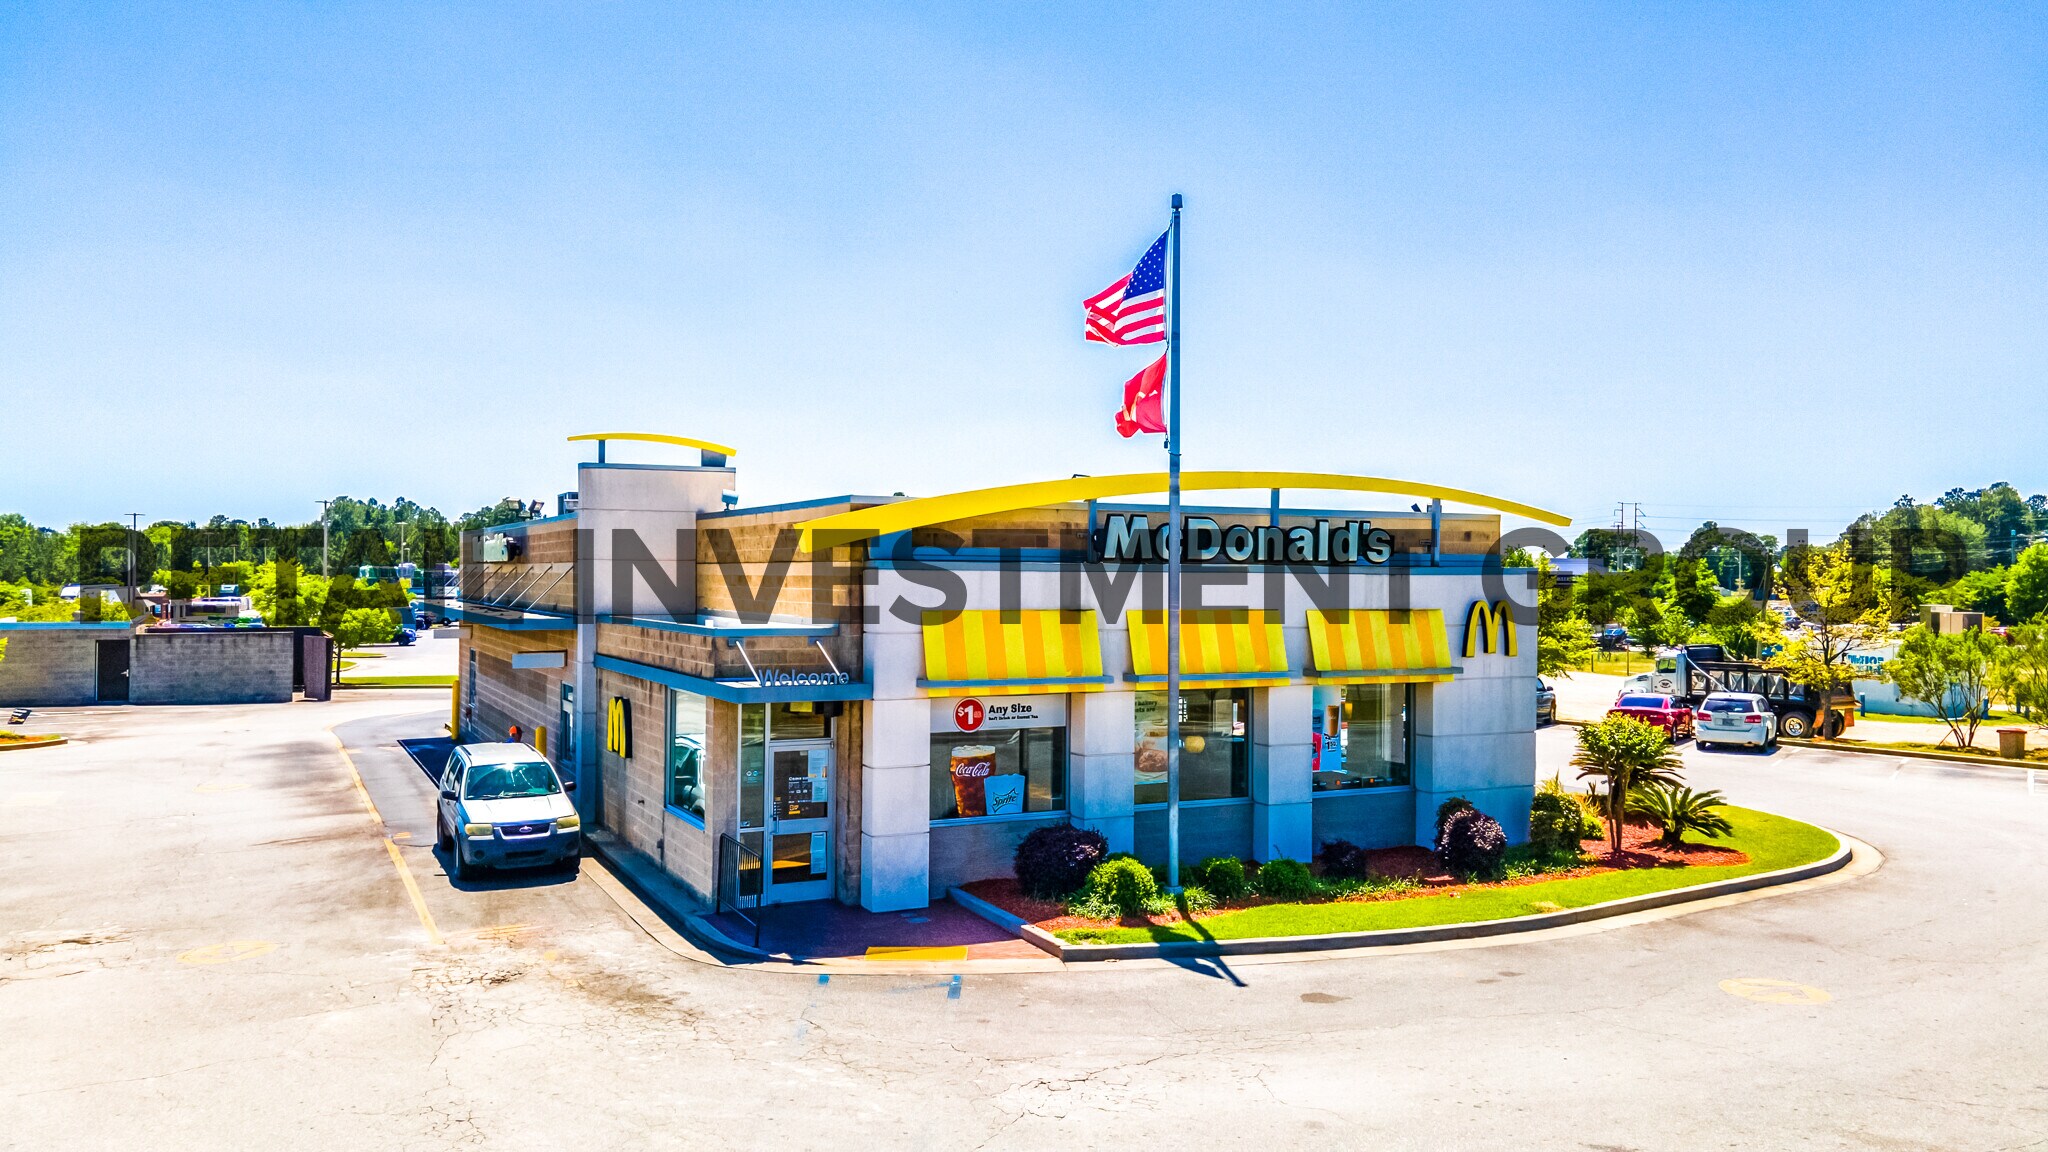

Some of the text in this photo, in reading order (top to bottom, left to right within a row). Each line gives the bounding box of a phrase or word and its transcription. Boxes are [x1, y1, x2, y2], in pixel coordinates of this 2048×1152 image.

[1102, 512, 1394, 563] McDonald's
[758, 669, 849, 686] Welcome
[988, 704, 1008, 716] Any
[1011, 703, 1032, 713] Size
[955, 762, 990, 777] Coca-Cola
[992, 795, 1017, 807] Sprite
